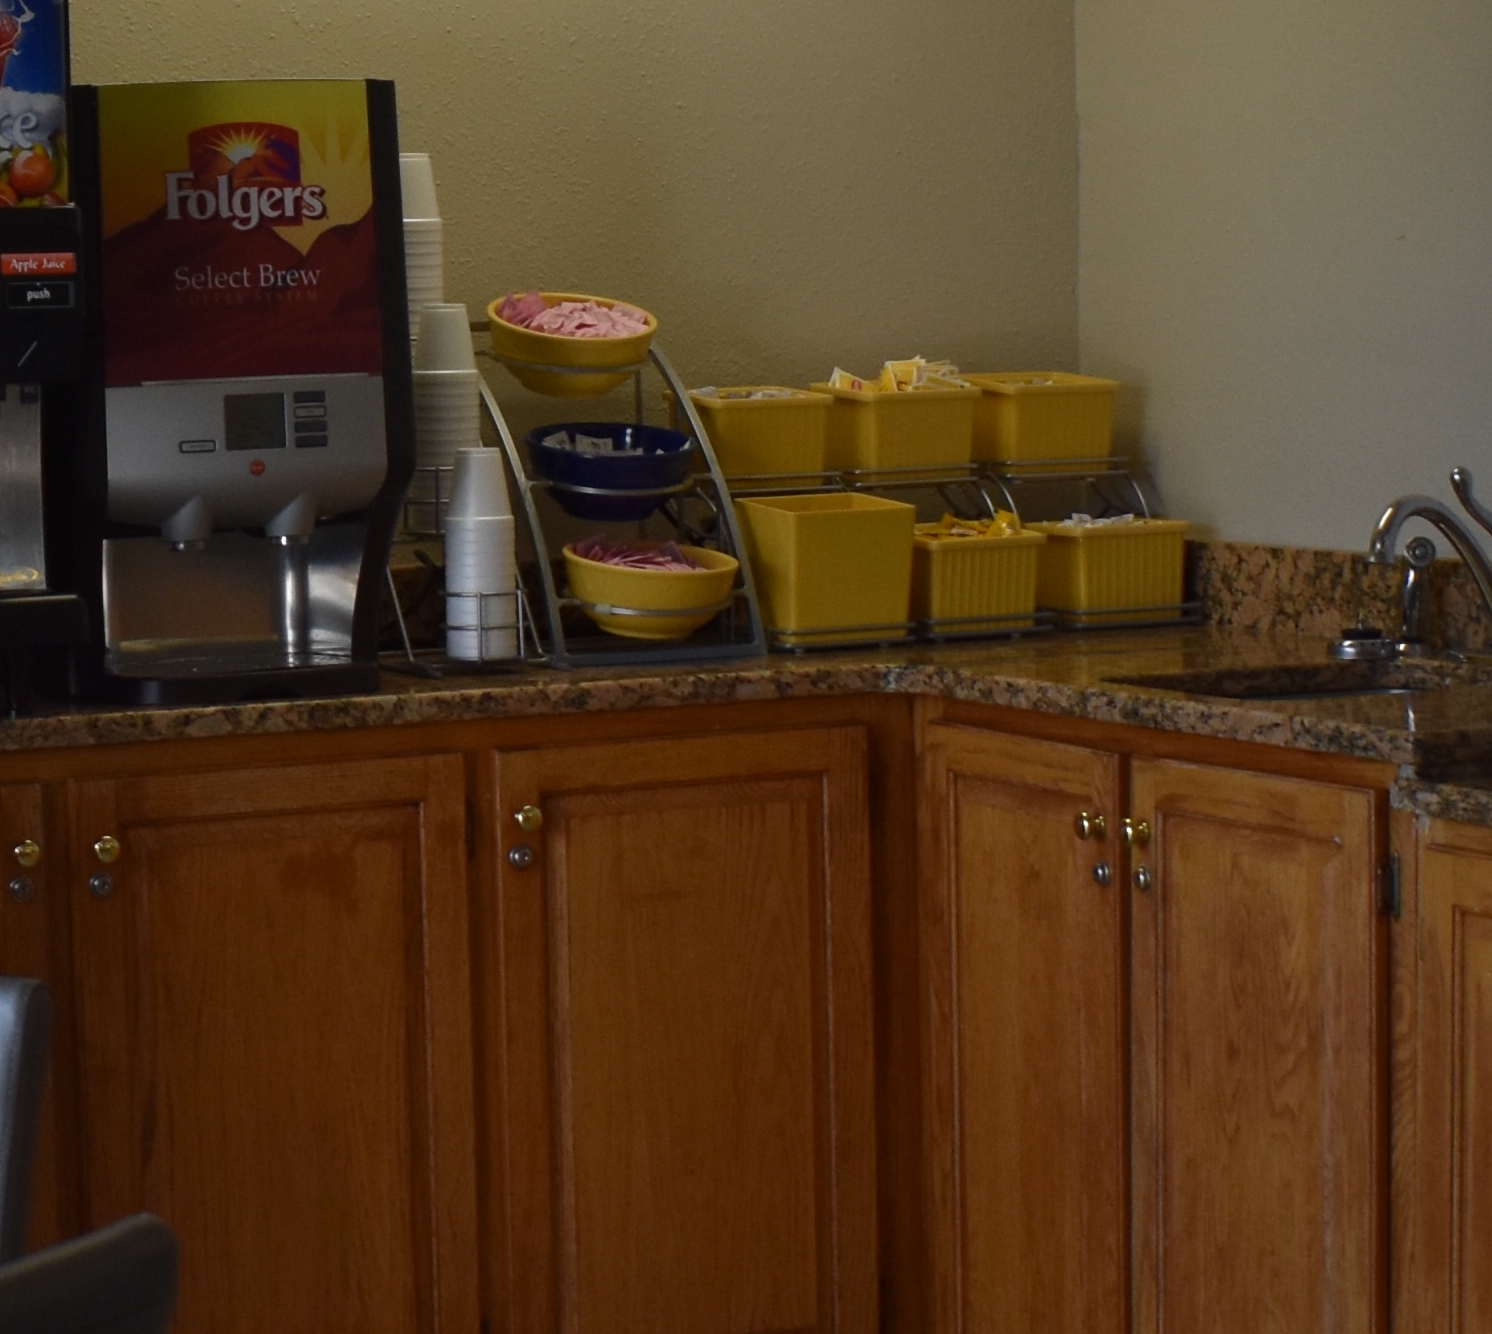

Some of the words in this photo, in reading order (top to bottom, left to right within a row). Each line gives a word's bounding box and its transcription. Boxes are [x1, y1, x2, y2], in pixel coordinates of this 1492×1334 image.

[165, 171, 326, 231] Folgers
[9, 258, 40, 272] Apple
[43, 257, 67, 270] Juice
[174, 265, 251, 291] Select
[259, 263, 321, 289] Brew
[27, 286, 51, 302] push
